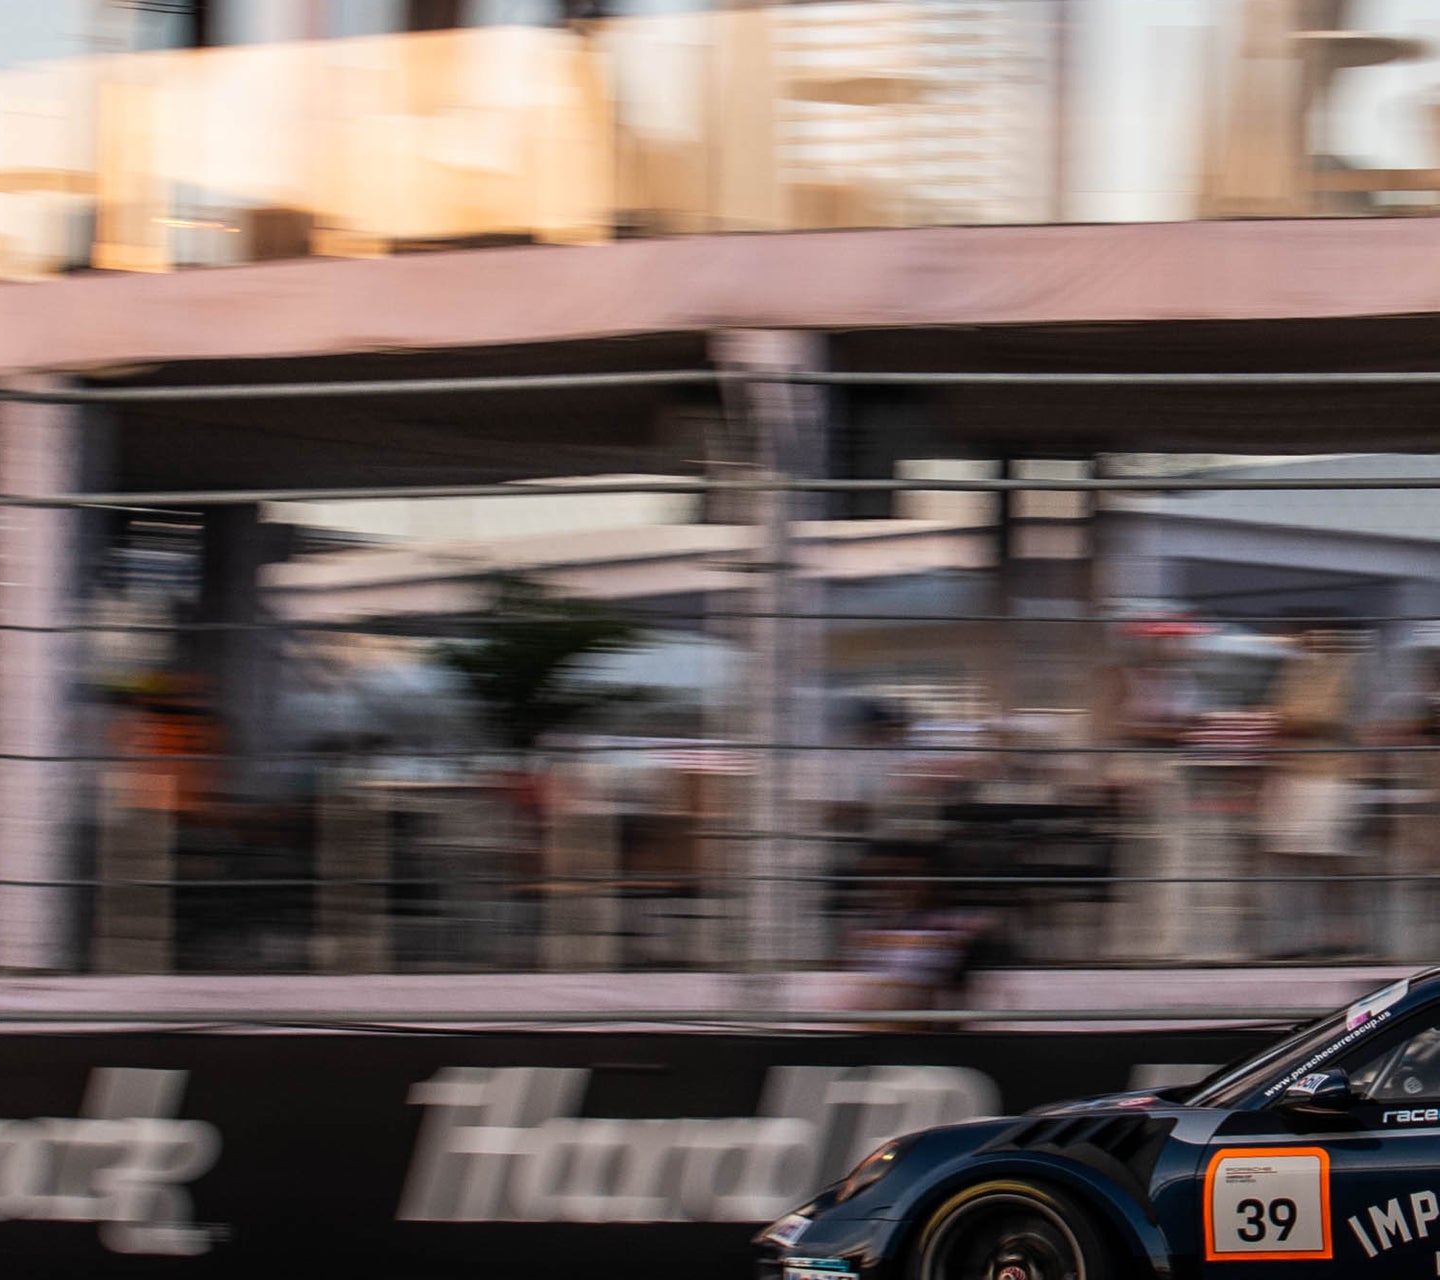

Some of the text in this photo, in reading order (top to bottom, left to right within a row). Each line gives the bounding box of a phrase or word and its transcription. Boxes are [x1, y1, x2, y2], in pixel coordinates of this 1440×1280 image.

[1263, 1010, 1392, 1098] www.porschecarreracup.us
[397, 1066, 860, 1223] Hard
[1236, 1198, 1298, 1243] 39
